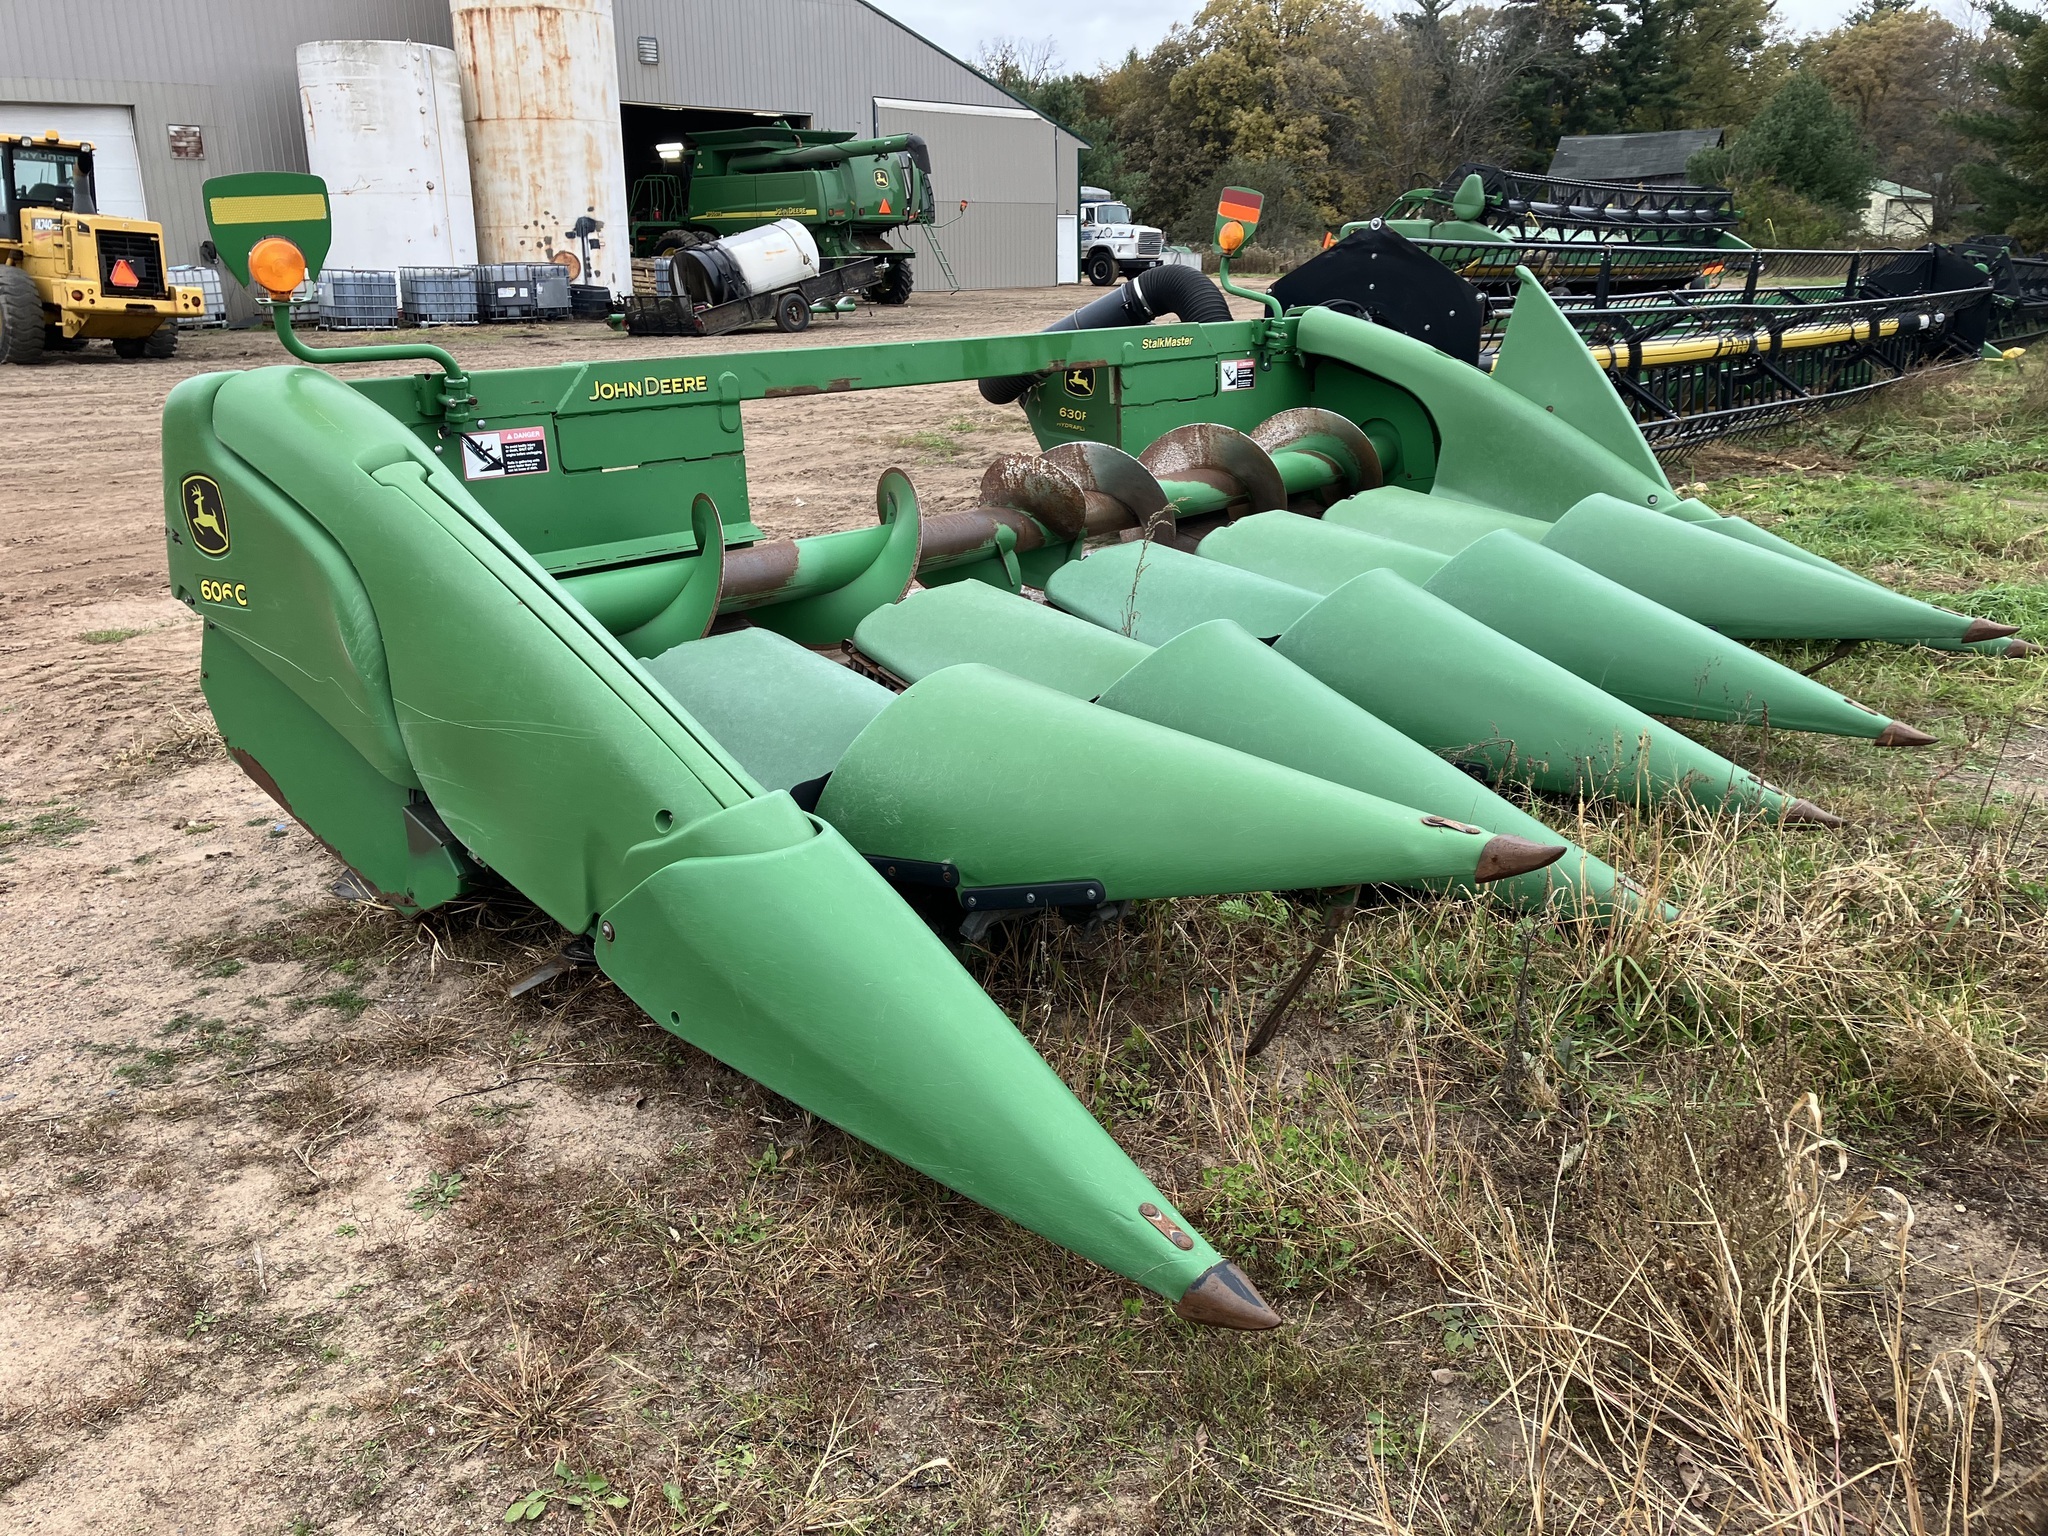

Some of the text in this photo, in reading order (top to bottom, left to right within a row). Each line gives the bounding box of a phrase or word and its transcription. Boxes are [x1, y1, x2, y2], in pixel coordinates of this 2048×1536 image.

[19, 151, 79, 163] HYUNDAI
[788, 206, 807, 215] DEERE
[1141, 335, 1194, 350] StalkMaster
[588, 376, 709, 402] JOHN DEERE
[513, 430, 541, 440] DANGER
